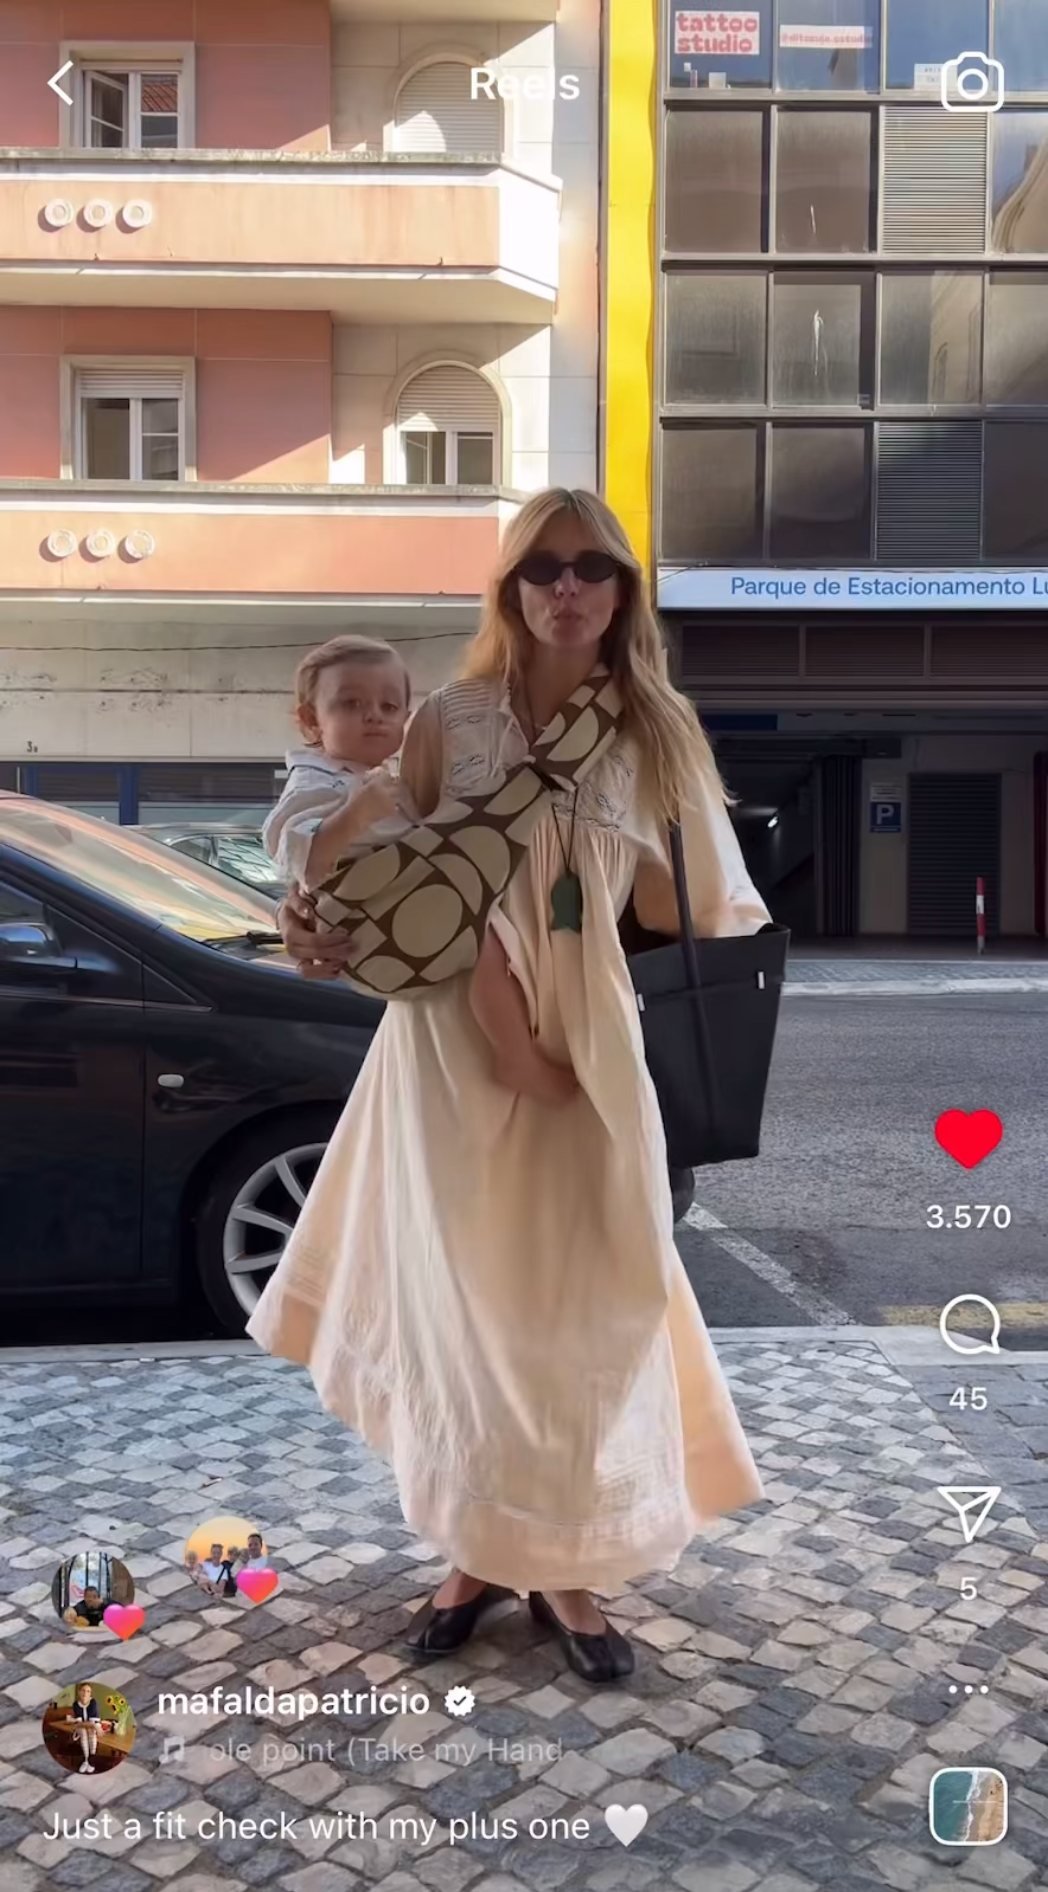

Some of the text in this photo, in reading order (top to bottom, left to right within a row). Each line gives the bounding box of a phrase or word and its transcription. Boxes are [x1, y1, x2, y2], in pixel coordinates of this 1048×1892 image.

[677, 12, 758, 32] tattoo
[678, 34, 753, 53] studio
[731, 577, 806, 599] Parque
[813, 577, 841, 595] de
[848, 576, 1025, 595] Estacionamento
[876, 803, 895, 825] P
